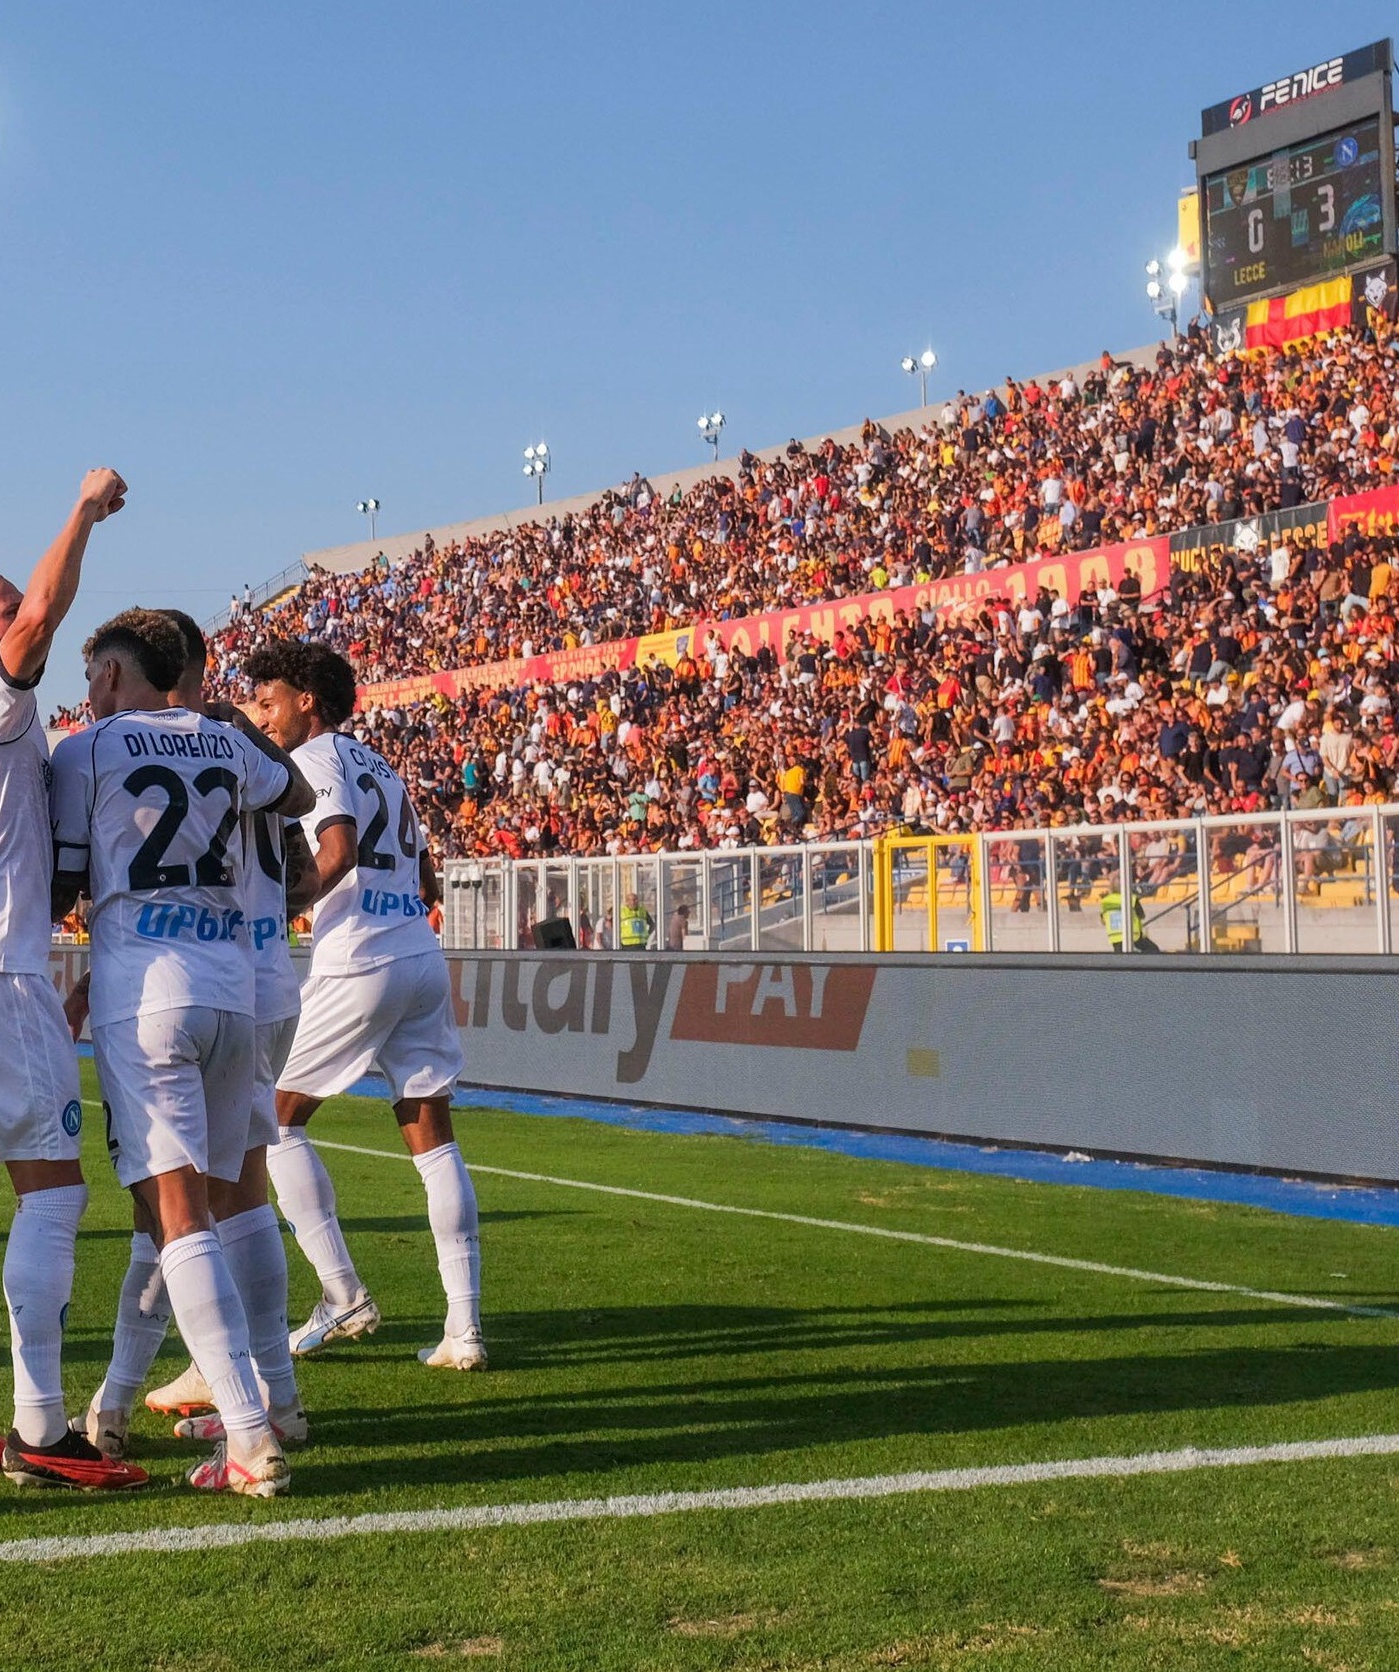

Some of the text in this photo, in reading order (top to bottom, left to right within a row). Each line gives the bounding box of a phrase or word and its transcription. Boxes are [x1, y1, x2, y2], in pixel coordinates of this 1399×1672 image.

[1260, 58, 1343, 111] FENICE
[1318, 184, 1335, 231] 3
[1234, 261, 1265, 286] LECCE
[124, 732, 234, 760] DI LORENZO
[315, 787, 332, 798] ay
[123, 764, 239, 891] 22
[356, 773, 417, 872] 24
[714, 964, 831, 1019] PAY
